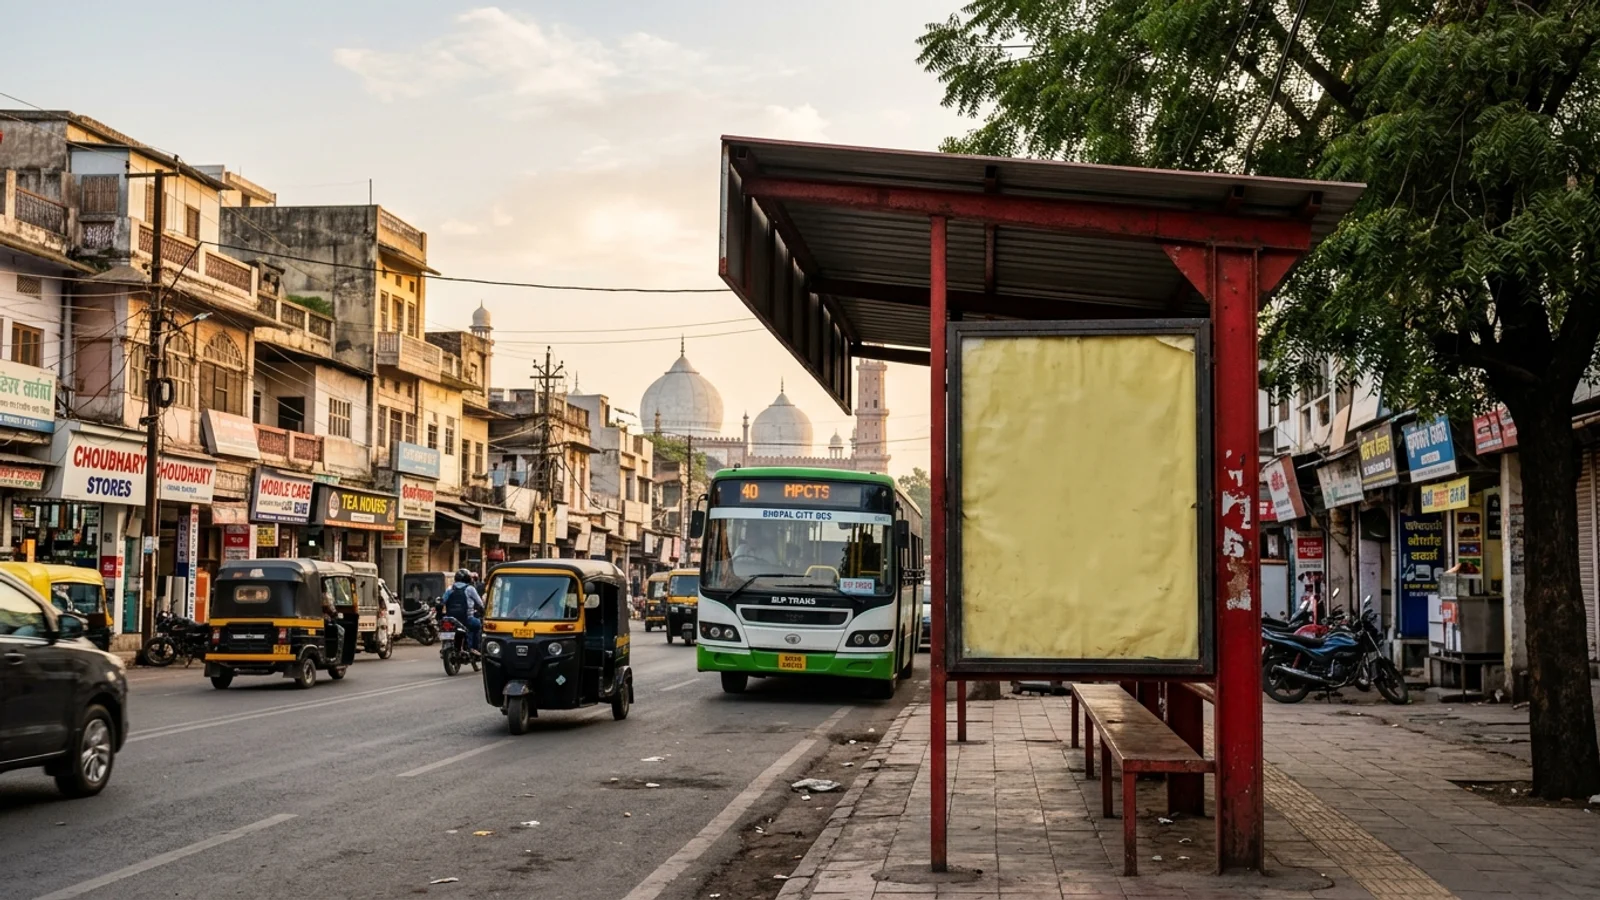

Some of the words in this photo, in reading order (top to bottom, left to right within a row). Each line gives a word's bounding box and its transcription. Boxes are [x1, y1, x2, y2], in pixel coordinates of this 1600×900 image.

[86, 476, 132, 498] STORES
[741, 483, 759, 499] 40
[342, 493, 359, 510] TEA
